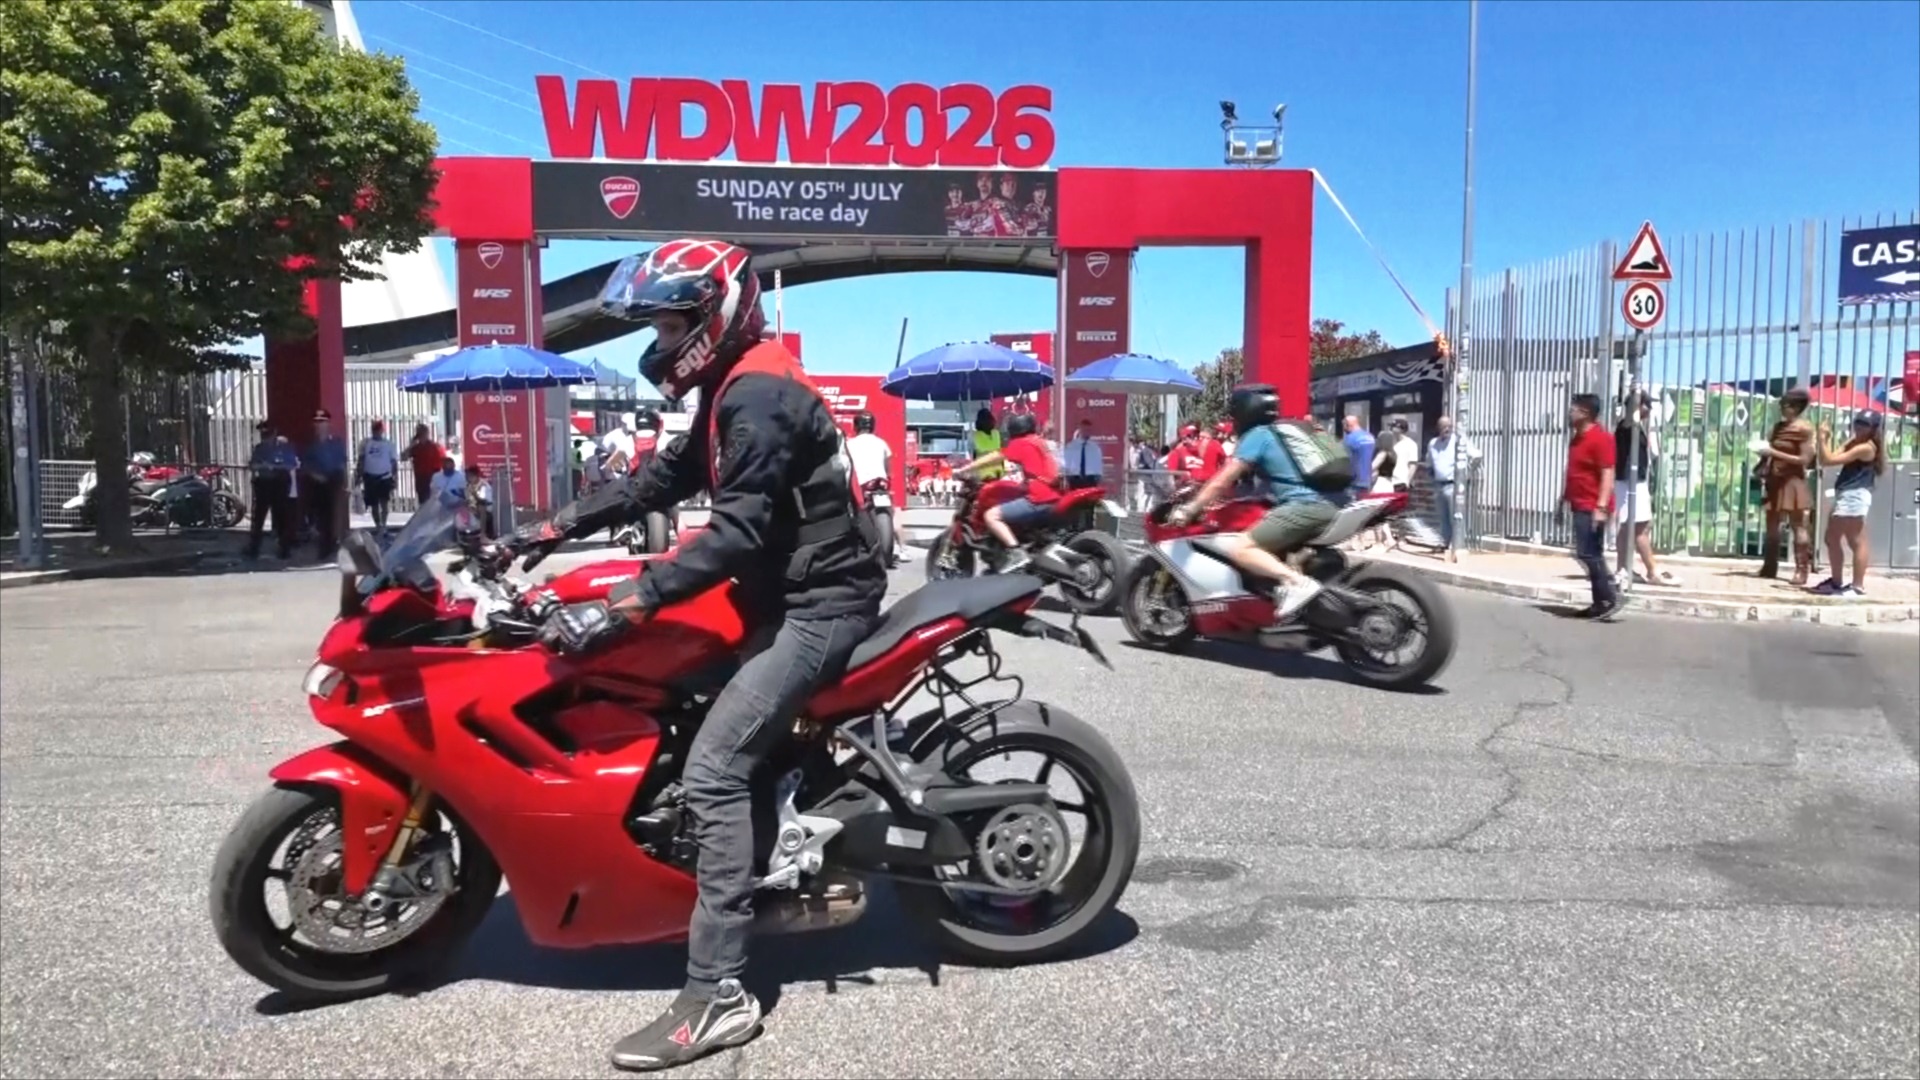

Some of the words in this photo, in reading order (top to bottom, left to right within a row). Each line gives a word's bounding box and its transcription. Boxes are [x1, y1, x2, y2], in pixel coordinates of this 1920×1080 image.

[535, 75, 1054, 168] WDW2026
[605, 183, 635, 191] DUCATI
[697, 179, 794, 199] SUNDAY
[800, 181, 845, 200] 05TH
[849, 183, 903, 201] JULY
[733, 202, 774, 220] The
[780, 206, 824, 221] race
[830, 204, 869, 226] day
[1852, 240, 1920, 267] CAS
[1633, 295, 1656, 315] 30
